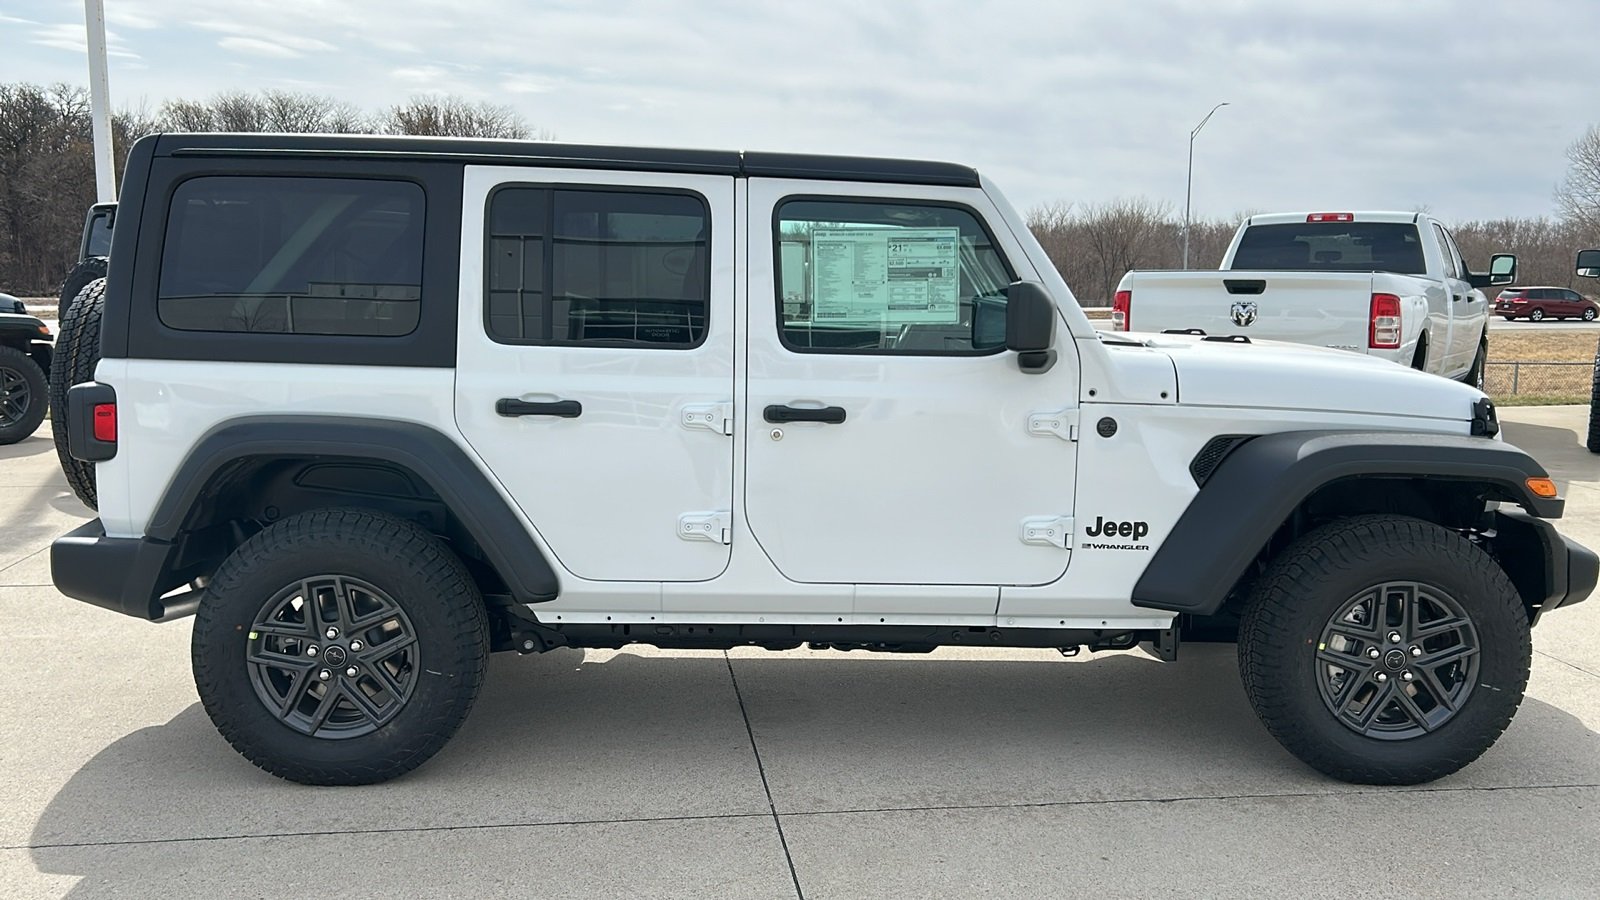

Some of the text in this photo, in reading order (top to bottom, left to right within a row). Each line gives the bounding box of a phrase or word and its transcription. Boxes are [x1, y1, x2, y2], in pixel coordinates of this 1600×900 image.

[892, 244, 902, 252] 21
[1086, 516, 1149, 541] Jeep
[1092, 543, 1150, 551] WRANGLER
